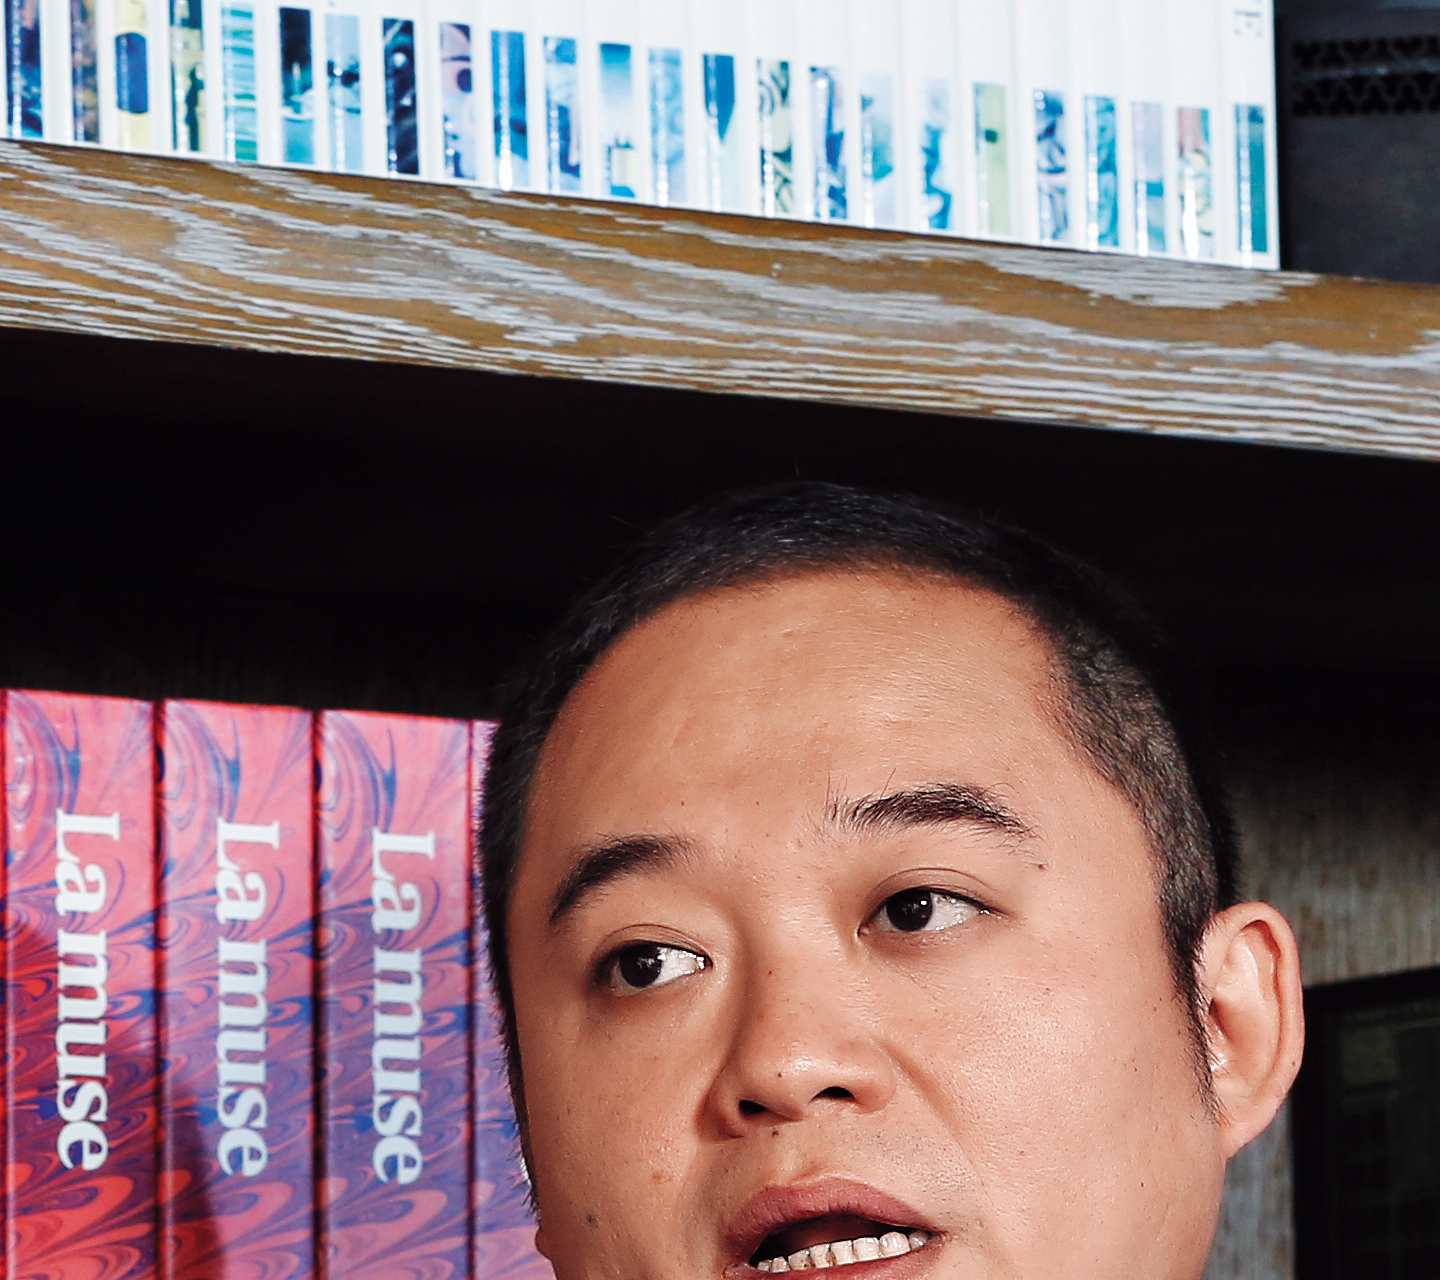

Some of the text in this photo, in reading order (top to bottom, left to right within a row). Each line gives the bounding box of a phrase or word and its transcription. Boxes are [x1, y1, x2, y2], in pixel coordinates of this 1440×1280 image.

[55, 808, 120, 1172] La muse
[215, 816, 280, 1178] La muse
[372, 827, 436, 1185] La muse
